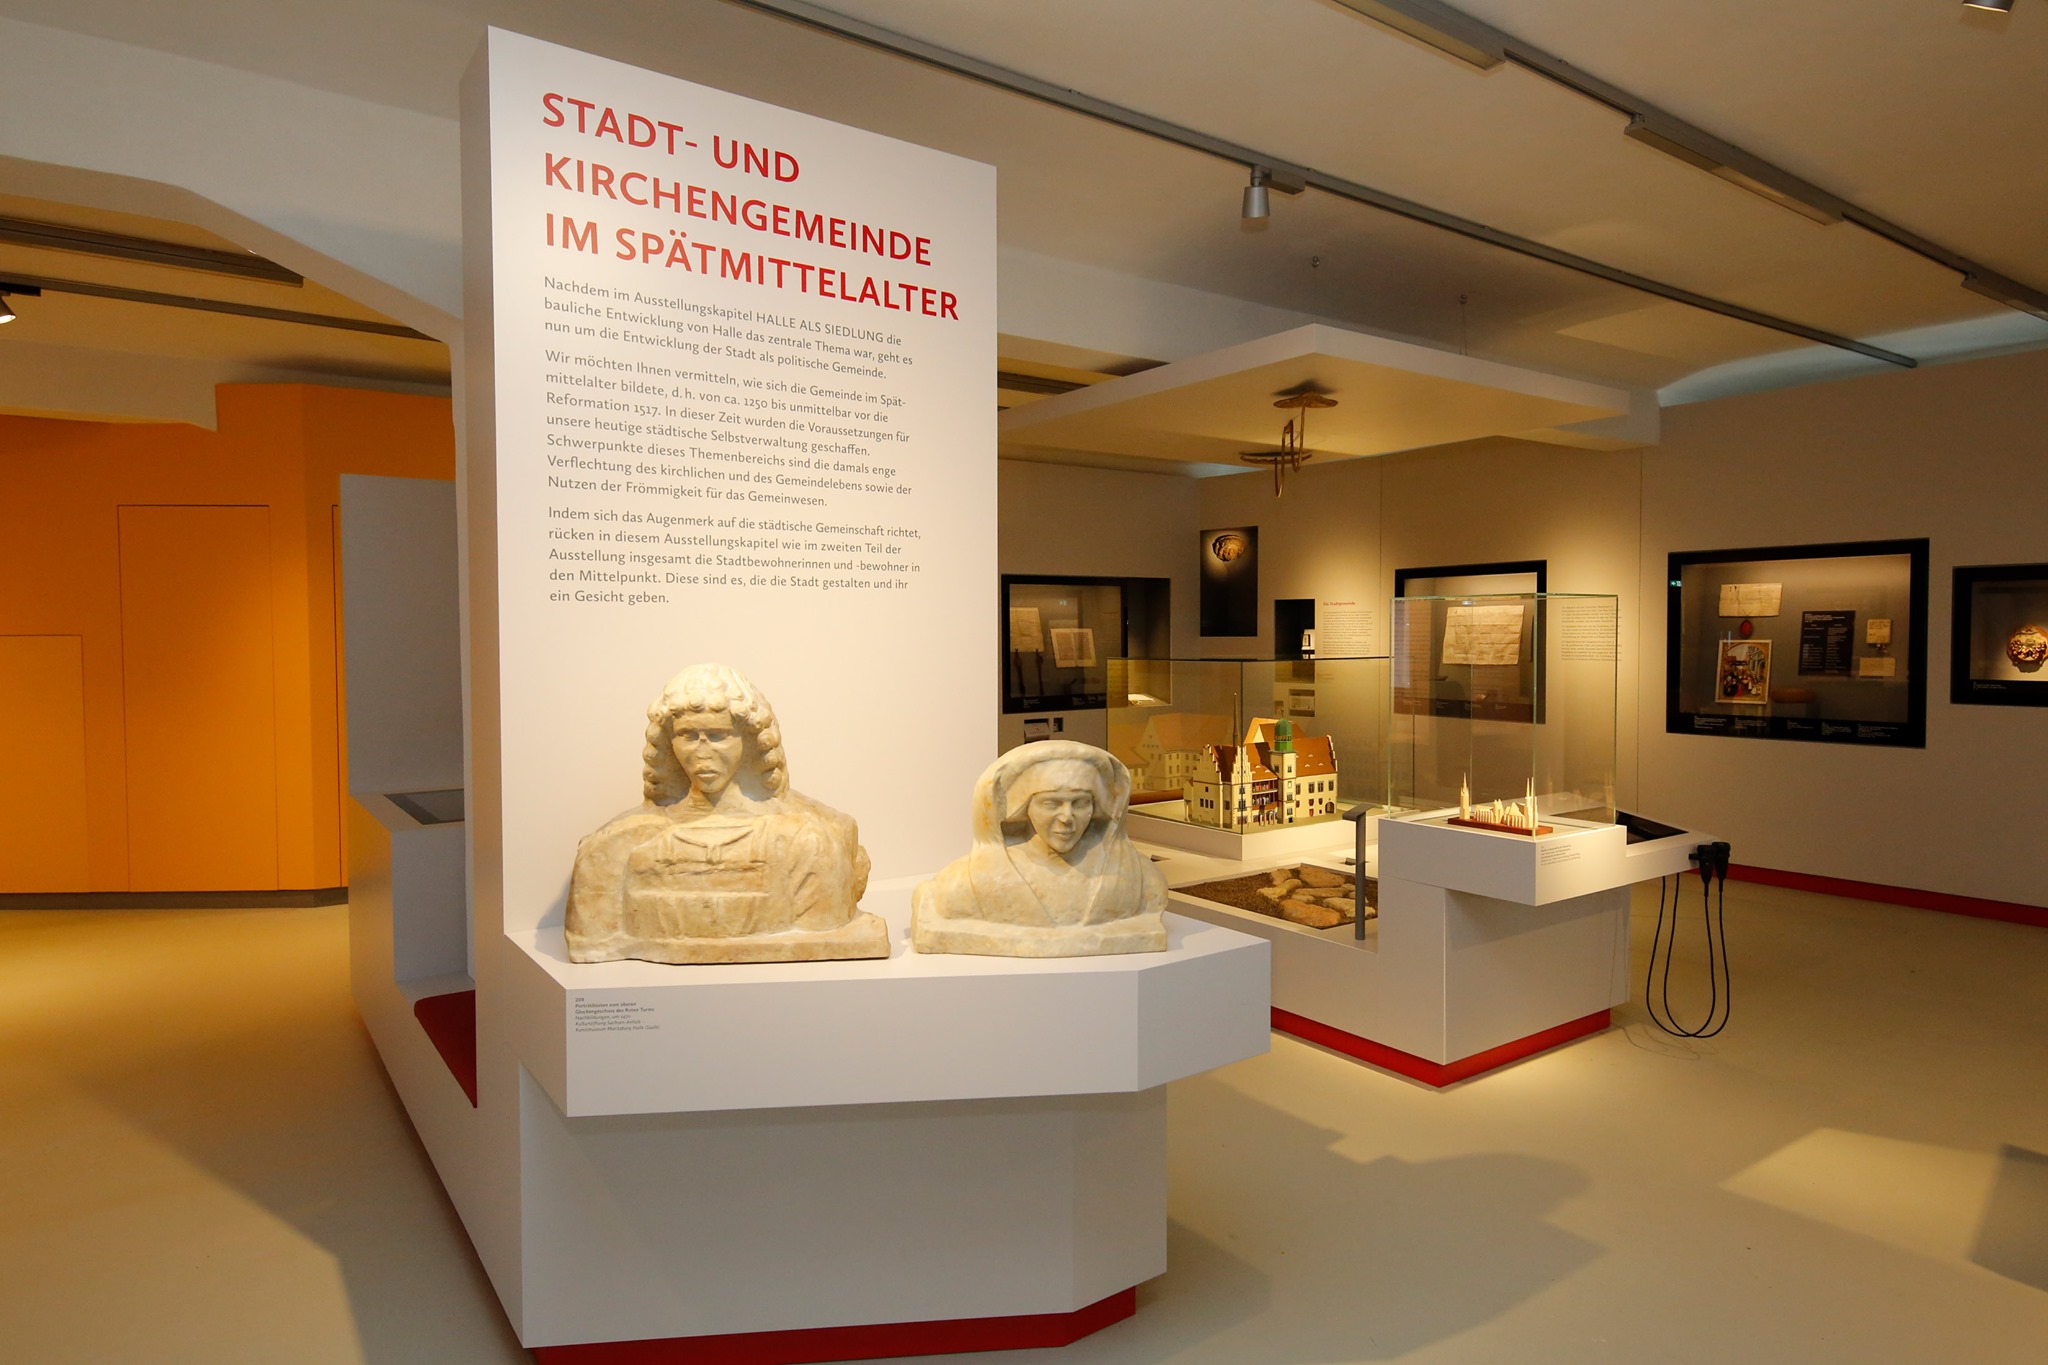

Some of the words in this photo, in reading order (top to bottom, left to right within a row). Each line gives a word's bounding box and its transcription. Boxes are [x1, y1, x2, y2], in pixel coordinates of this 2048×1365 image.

[543, 93, 697, 155] STADT-
[713, 135, 799, 182] UND
[545, 153, 931, 266] KIRCHENGEMEINDE
[547, 213, 598, 254] IM
[616, 228, 959, 320] SPÄTMITTELALTER
[545, 276, 609, 297] Nachdem
[614, 288, 629, 301] im
[634, 292, 752, 321] Ausstellungskapitel
[757, 312, 796, 328] HALLE
[799, 320, 821, 332] ALS
[825, 324, 883, 343] SIEDLUNG
[887, 334, 901, 345] die
[545, 297, 601, 317] bauliche
[607, 307, 684, 333] Entwicklung
[687, 323, 708, 334] von
[713, 324, 743, 340] Halle
[746, 330, 765, 342] das
[768, 336, 812, 350] zentrale
[815, 340, 850, 356] Thema
[853, 349, 875, 361] war,
[878, 352, 900, 363] geht
[903, 357, 912, 365] es
[545, 322, 570, 333] nun
[575, 326, 595, 336] um
[600, 327, 619, 340] die
[624, 330, 699, 355] Entwicklung
[703, 342, 723, 355] der
[726, 346, 756, 360] Stadt
[760, 351, 775, 363] als
[778, 355, 829, 370] politische
[832, 362, 887, 378] Gemeinde.
[545, 350, 570, 363] Wir
[575, 355, 632, 372] möchten
[637, 362, 671, 377] Ihnen
[675, 370, 739, 388] vermitteln,
[743, 377, 762, 389] wie
[766, 380, 787, 392] sich
[791, 382, 806, 394] die
[810, 385, 862, 401] Gemeinde
[865, 392, 877, 404] im
[880, 395, 906, 408] Spät-
[546, 372, 617, 390] mittelalter
[621, 379, 667, 399] bildete,
[699, 393, 720, 403] von
[724, 396, 740, 405] ca.
[744, 398, 768, 410] 1250
[771, 398, 786, 410] bis
[790, 404, 852, 418] unmittelbar
[854, 411, 871, 421] vor
[874, 411, 888, 422] die
[547, 392, 629, 412] Reformation
[634, 405, 661, 418] 1517.
[666, 405, 676, 417] In
[680, 407, 715, 421] dieser
[719, 411, 741, 424] Zeit
[744, 417, 786, 429] wurden
[789, 419, 805, 431] die
[808, 421, 893, 442] Voraussetzungen
[896, 431, 909, 442] für
[547, 416, 590, 428] unsere
[595, 417, 642, 436] heutige
[646, 424, 707, 440] städtische
[711, 430, 808, 453] Selbstverwaltung
[811, 442, 870, 456] geschaffen.
[547, 434, 643, 453] Schwerpunkte
[647, 443, 685, 457] dieses
[689, 447, 785, 466] Themenbereichs
[789, 457, 810, 468] sind
[814, 459, 829, 470] die
[833, 460, 869, 473] damals
[872, 467, 896, 478] enge
[547, 455, 632, 476] Verflechtung
[636, 462, 657, 474] des
[661, 464, 725, 480] kirchlichen
[729, 471, 750, 482] und
[754, 472, 772, 484] des
[776, 474, 862, 491] Gemeindelebens
[865, 483, 893, 493] sowie
[896, 484, 912, 494] der
[549, 476, 596, 490] Nutzen
[601, 479, 622, 492] der
[626, 481, 702, 499] Frömmigkeit
[706, 487, 723, 498] für
[726, 489, 745, 500] das
[748, 491, 827, 506] Gemeinwesen.
[549, 506, 589, 520] Indem
[594, 509, 618, 521] sich
[622, 510, 642, 523] das
[646, 512, 714, 528] Augenmerk
[718, 517, 737, 528] auf
[739, 517, 755, 529] die
[759, 520, 812, 532] städtische
[816, 523, 884, 536] Gemeinschaft
[887, 527, 921, 539] richtet,
[549, 528, 594, 540] rücken
[599, 530, 610, 541] in
[615, 530, 660, 543] diesem
[664, 533, 778, 551] Ausstellungskapitel
[782, 539, 801, 550] wie
[805, 540, 817, 550] im
[821, 542, 861, 552] zweiten
[865, 543, 882, 553] Teil
[885, 544, 901, 554] der
[549, 548, 626, 565] Ausstellung
[630, 551, 691, 566] insgesamt
[695, 553, 712, 565] die
[716, 555, 830, 569] Stadtbewohnerinnen
[834, 560, 852, 570] und
[856, 560, 909, 572] -bewohner
[912, 562, 920, 572] in
[550, 569, 574, 581] den
[580, 570, 661, 585] Mittelpunkt.
[666, 573, 699, 584] Diese
[703, 574, 726, 584] sind
[731, 577, 746, 587] es,
[750, 575, 766, 585] die
[770, 575, 786, 586] die
[790, 576, 819, 587] Stadt
[823, 577, 870, 590] gestalten
[874, 578, 892, 588] und
[895, 579, 908, 589] ihr
[550, 590, 570, 601] ein
[575, 590, 624, 602] Gesicht
[628, 591, 669, 606] geben.
